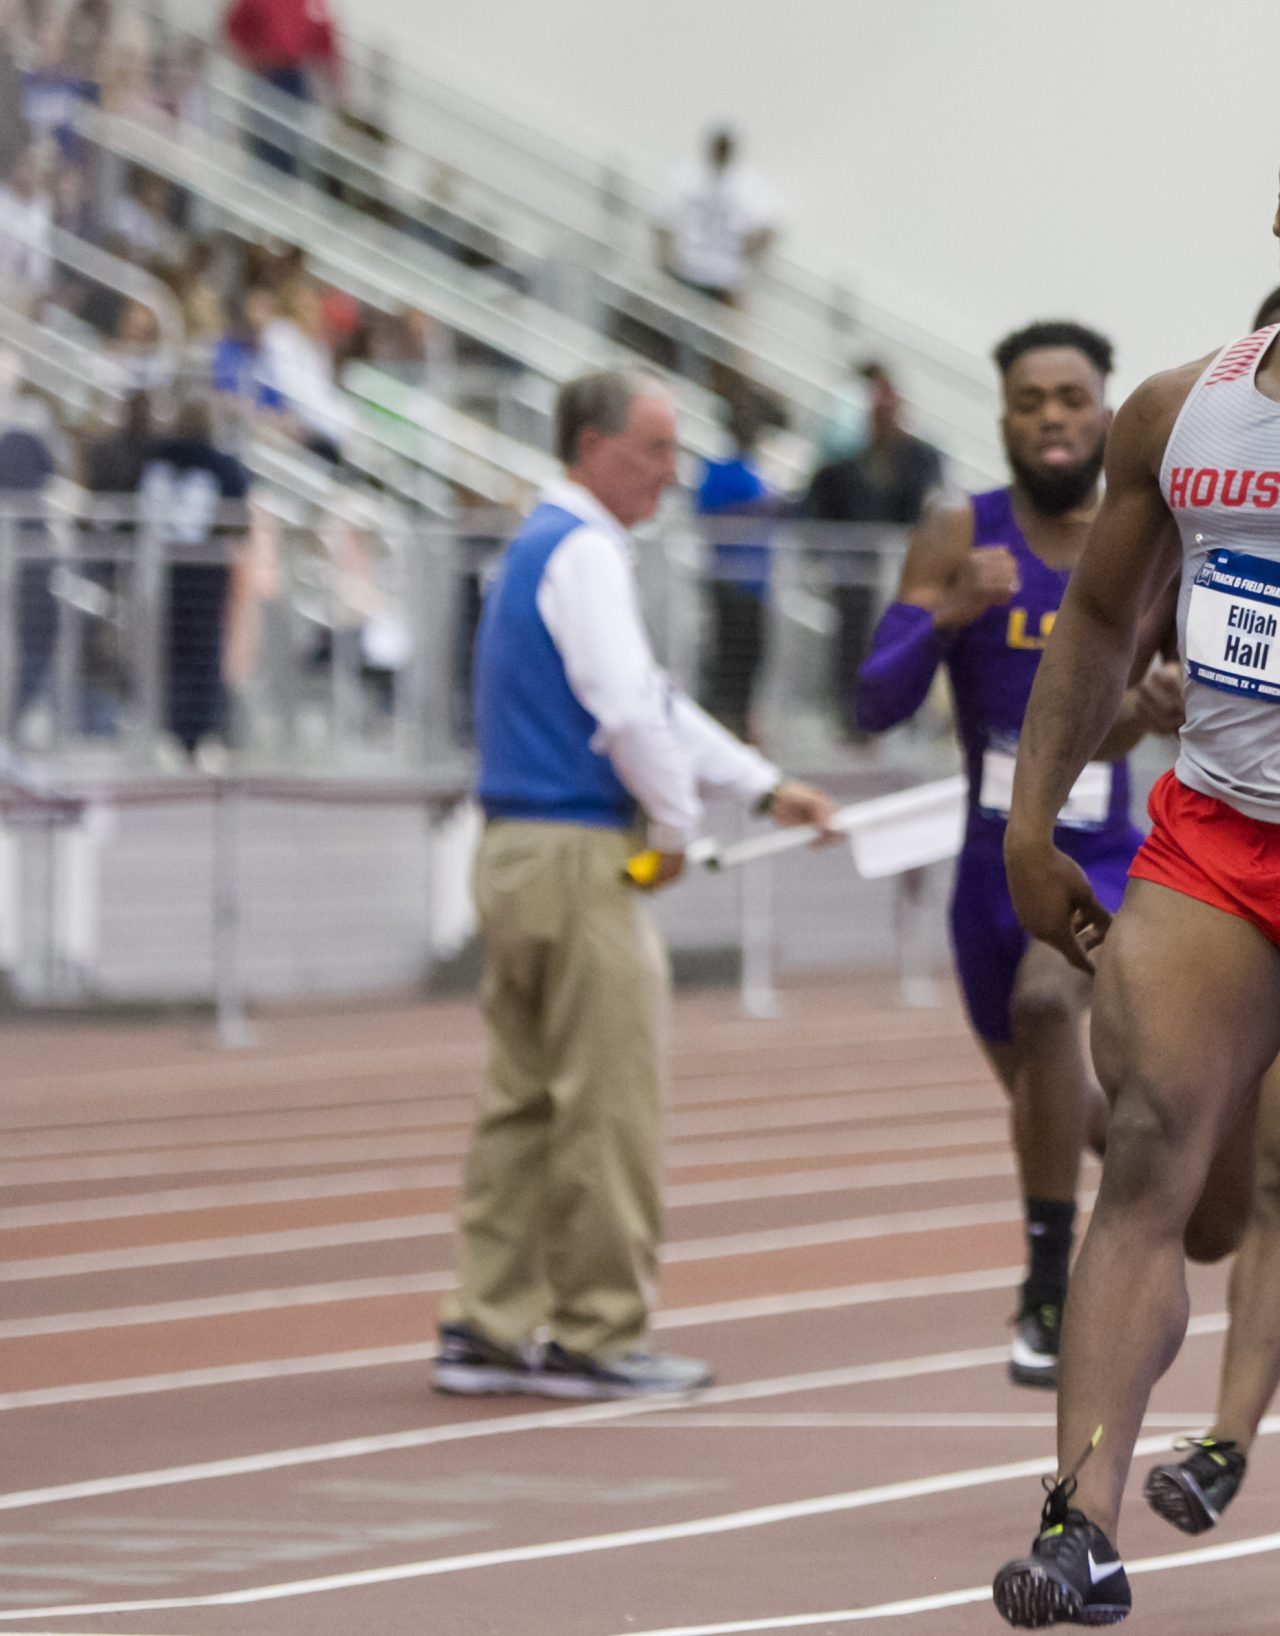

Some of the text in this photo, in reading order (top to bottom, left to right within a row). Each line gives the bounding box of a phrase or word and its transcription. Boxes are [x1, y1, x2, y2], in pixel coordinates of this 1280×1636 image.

[1212, 571, 1234, 587] TRACK
[1240, 578, 1264, 595] FIELD
[1227, 605, 1278, 637] Elijah
[1224, 635, 1270, 671] Hall
